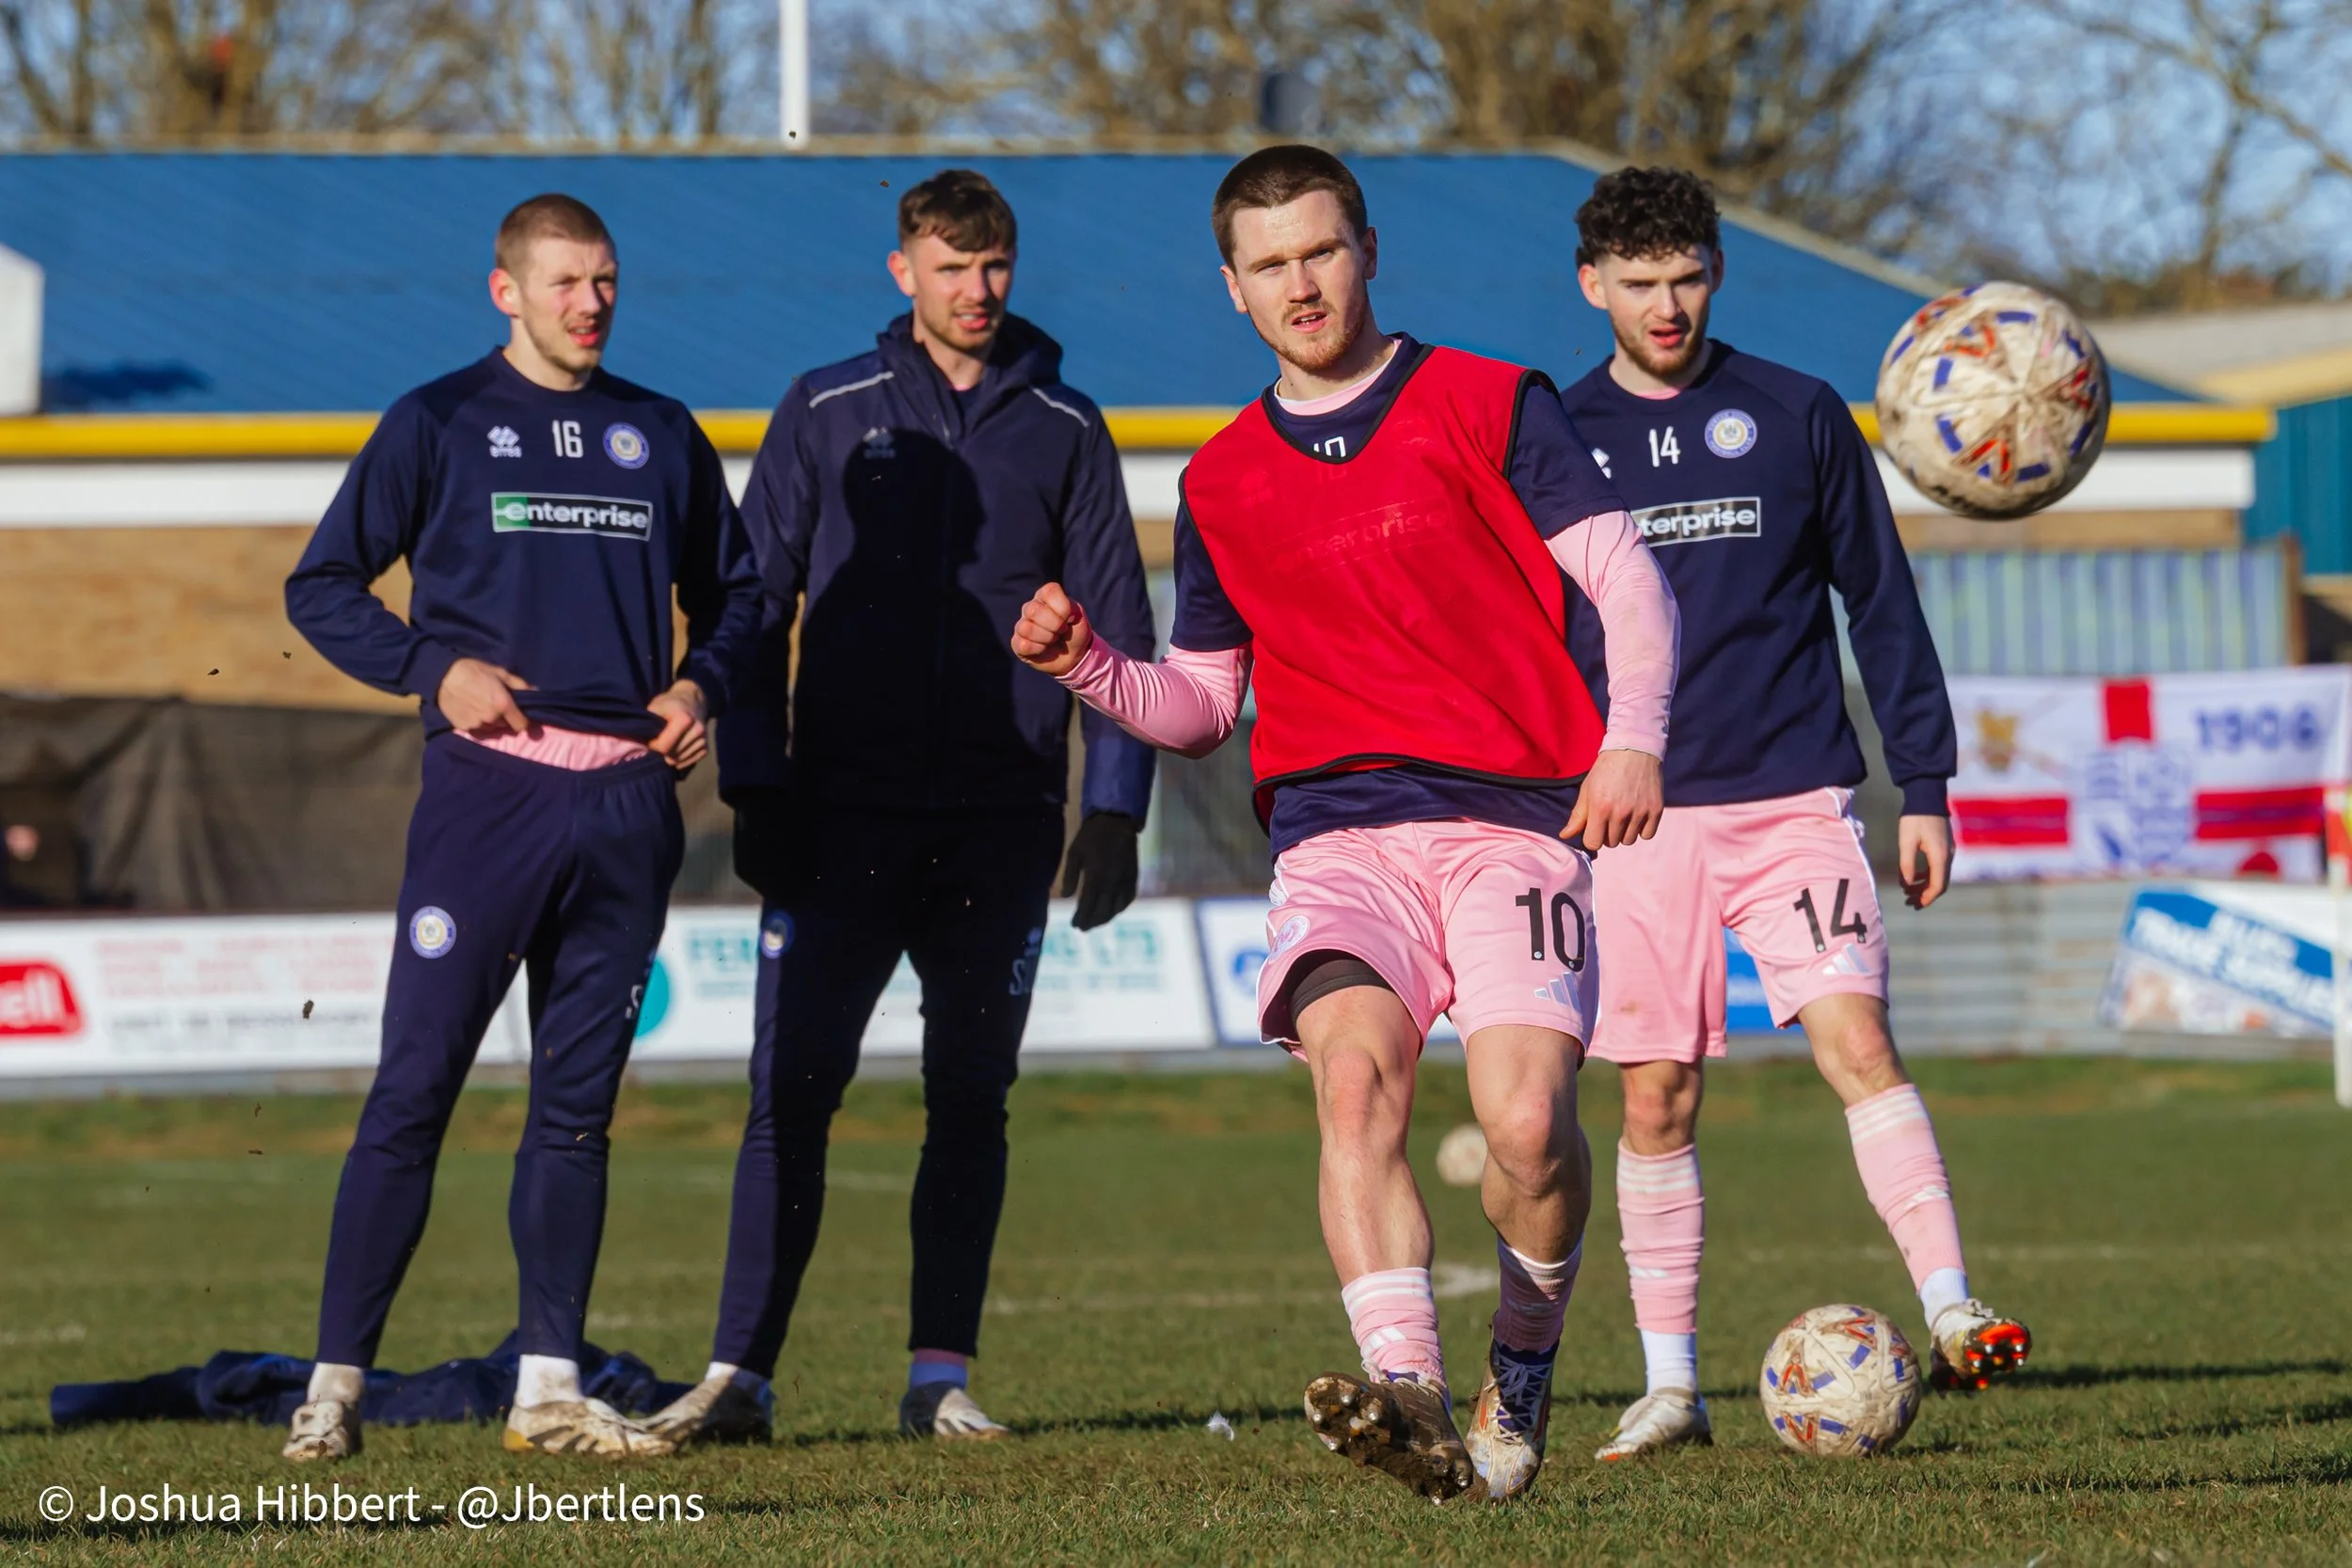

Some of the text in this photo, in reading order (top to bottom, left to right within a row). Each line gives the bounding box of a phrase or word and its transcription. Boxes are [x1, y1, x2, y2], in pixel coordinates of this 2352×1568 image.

[551, 420, 583, 458] 16
[1648, 425, 1681, 467] 14
[501, 501, 649, 529] enterprise
[1639, 508, 1756, 536] terprise
[1516, 887, 1585, 973] 10
[1792, 879, 1867, 953] 14
